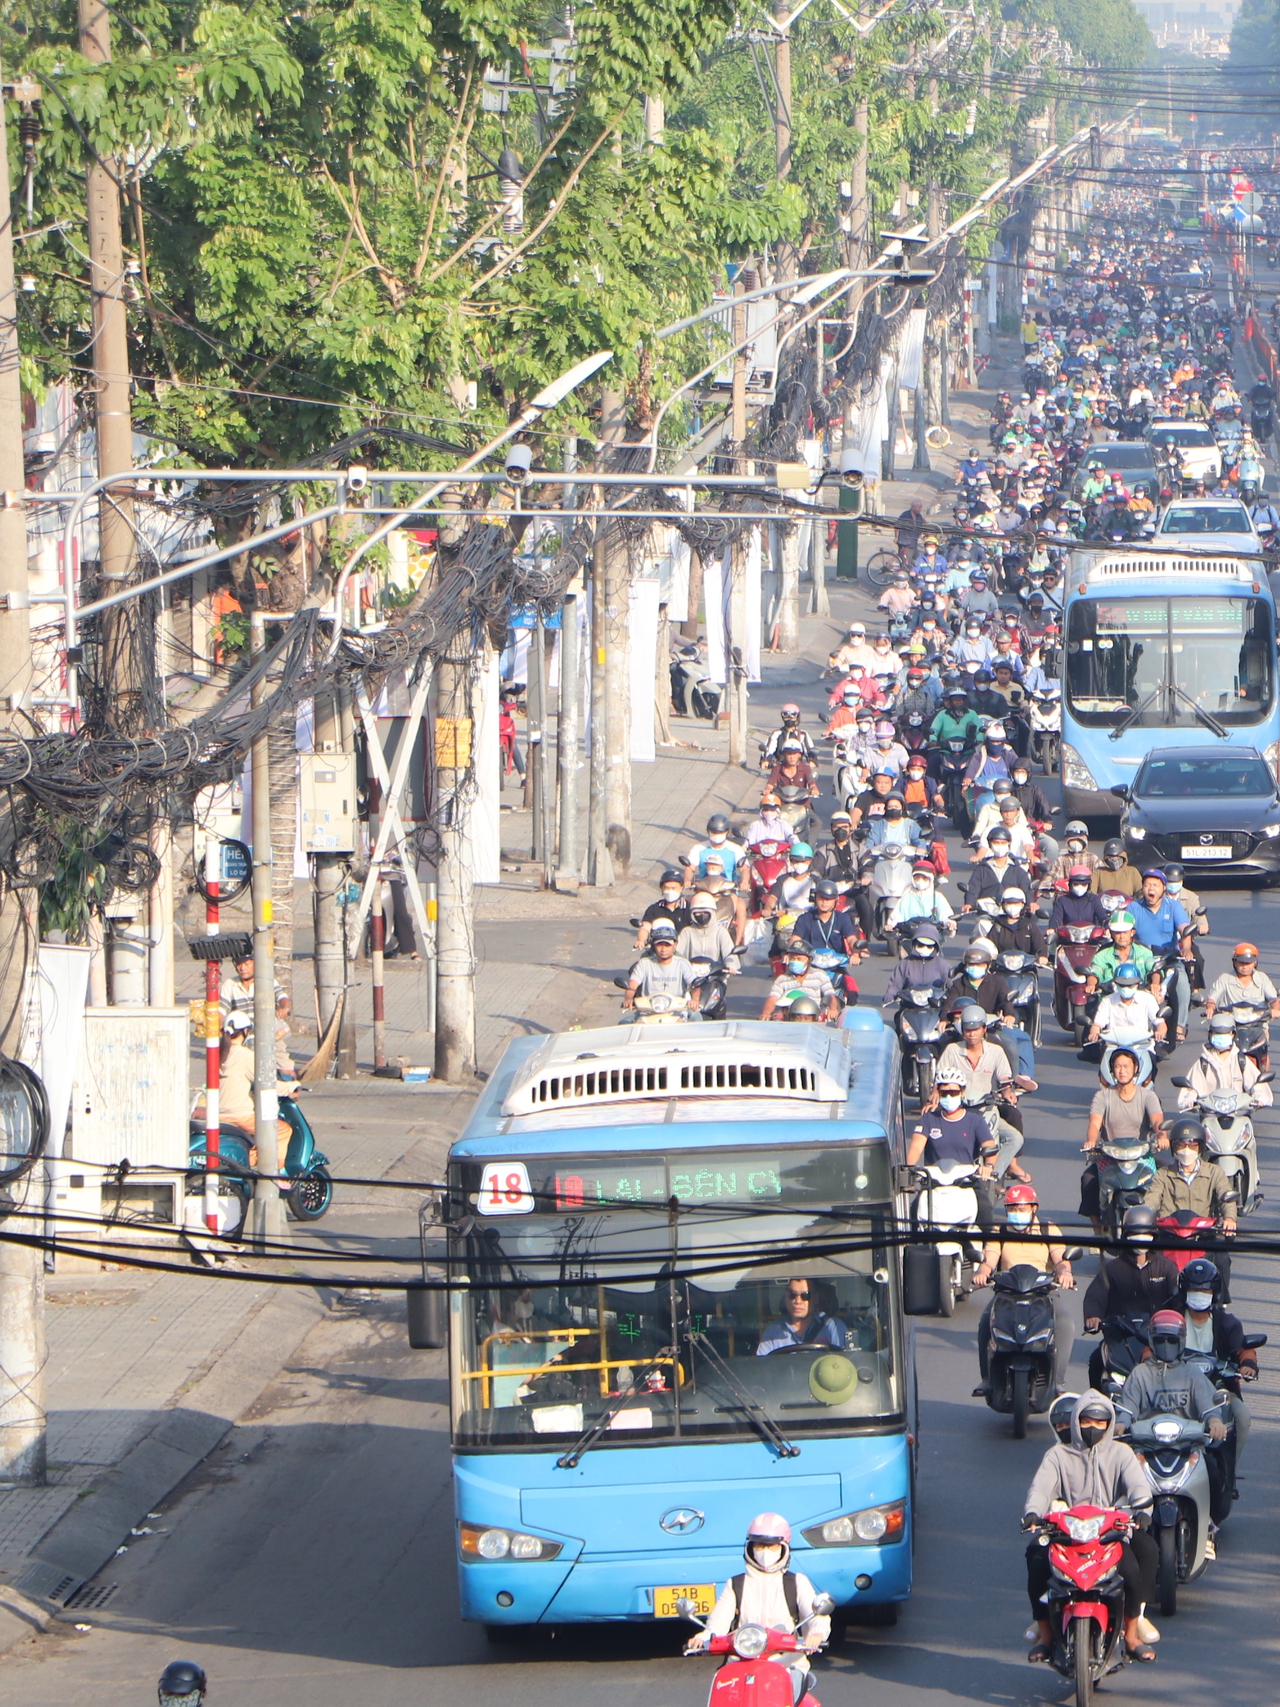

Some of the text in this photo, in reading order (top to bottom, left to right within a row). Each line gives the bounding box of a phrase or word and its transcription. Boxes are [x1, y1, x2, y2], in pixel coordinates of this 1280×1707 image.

[488, 1173, 521, 1205] 18
[1146, 1389, 1189, 1409] VANS
[672, 1587, 698, 1601] 51B
